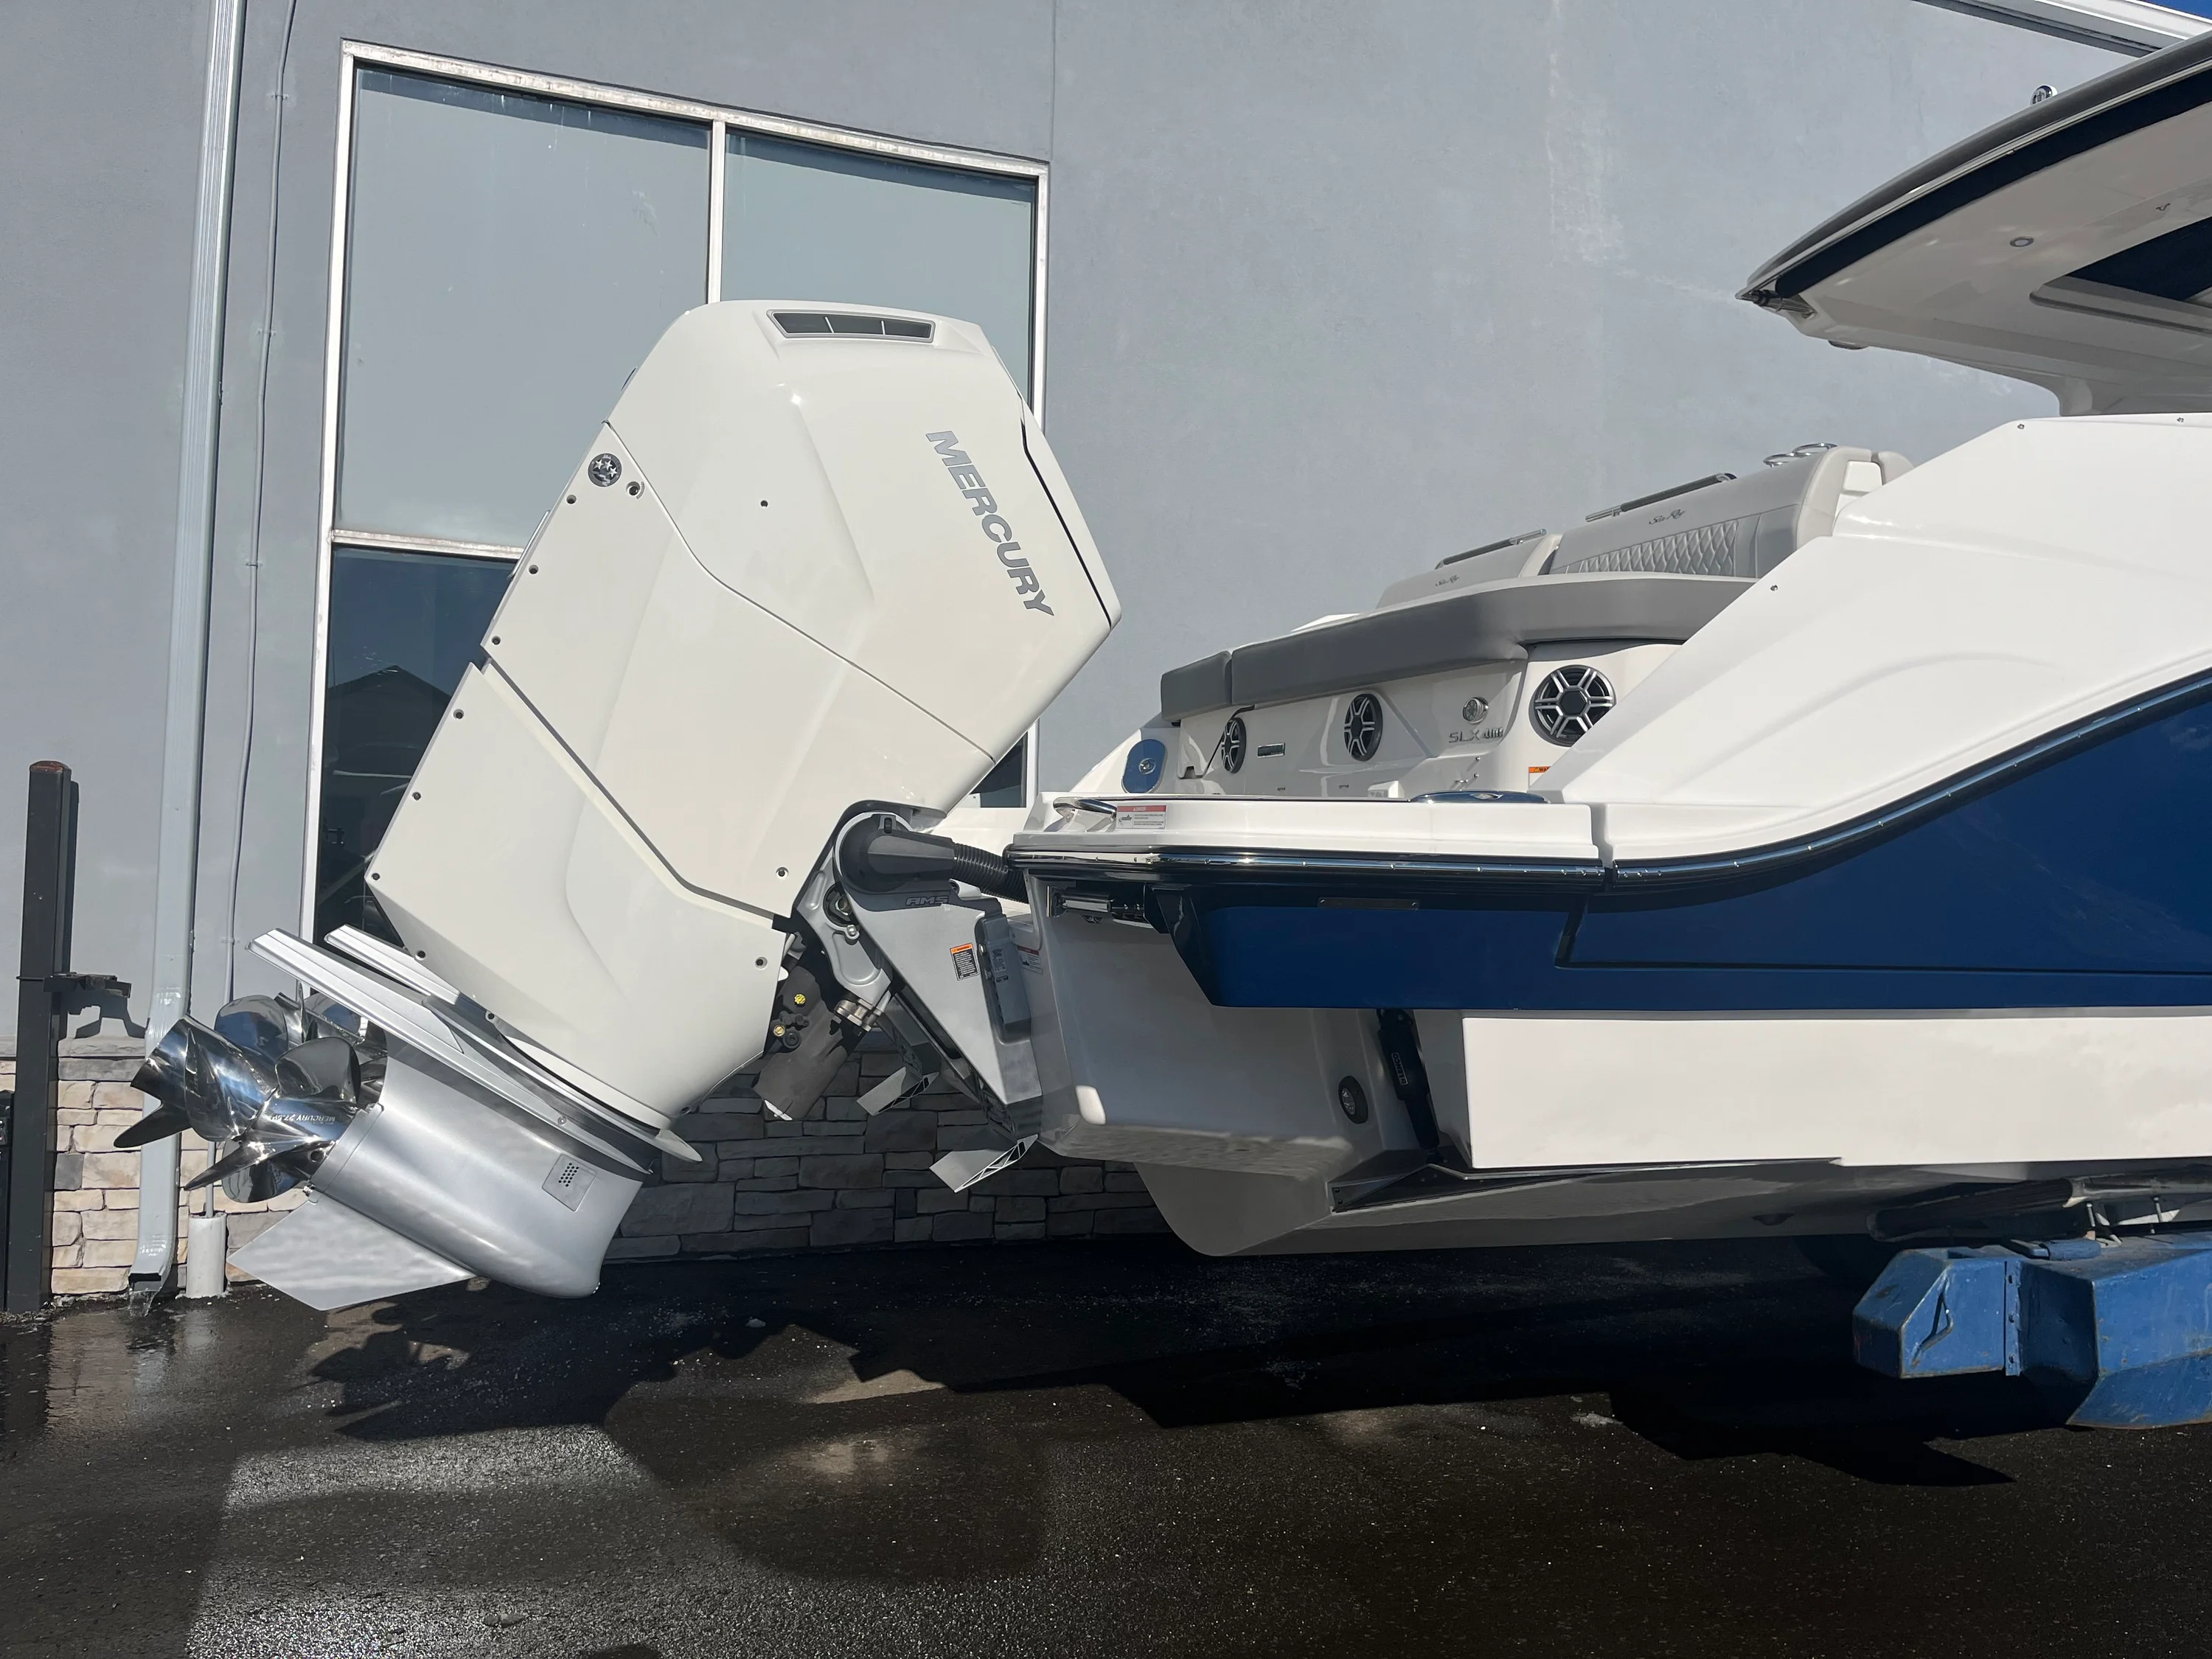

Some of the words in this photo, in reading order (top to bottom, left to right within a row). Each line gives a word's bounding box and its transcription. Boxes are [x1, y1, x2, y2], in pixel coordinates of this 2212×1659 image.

[925, 431, 1054, 616] MERCURY
[1449, 729, 1480, 743] SLX
[905, 896, 949, 905] AMS
[1393, 1054, 1405, 1078] LENCO
[296, 1114, 335, 1122] MERCURY
